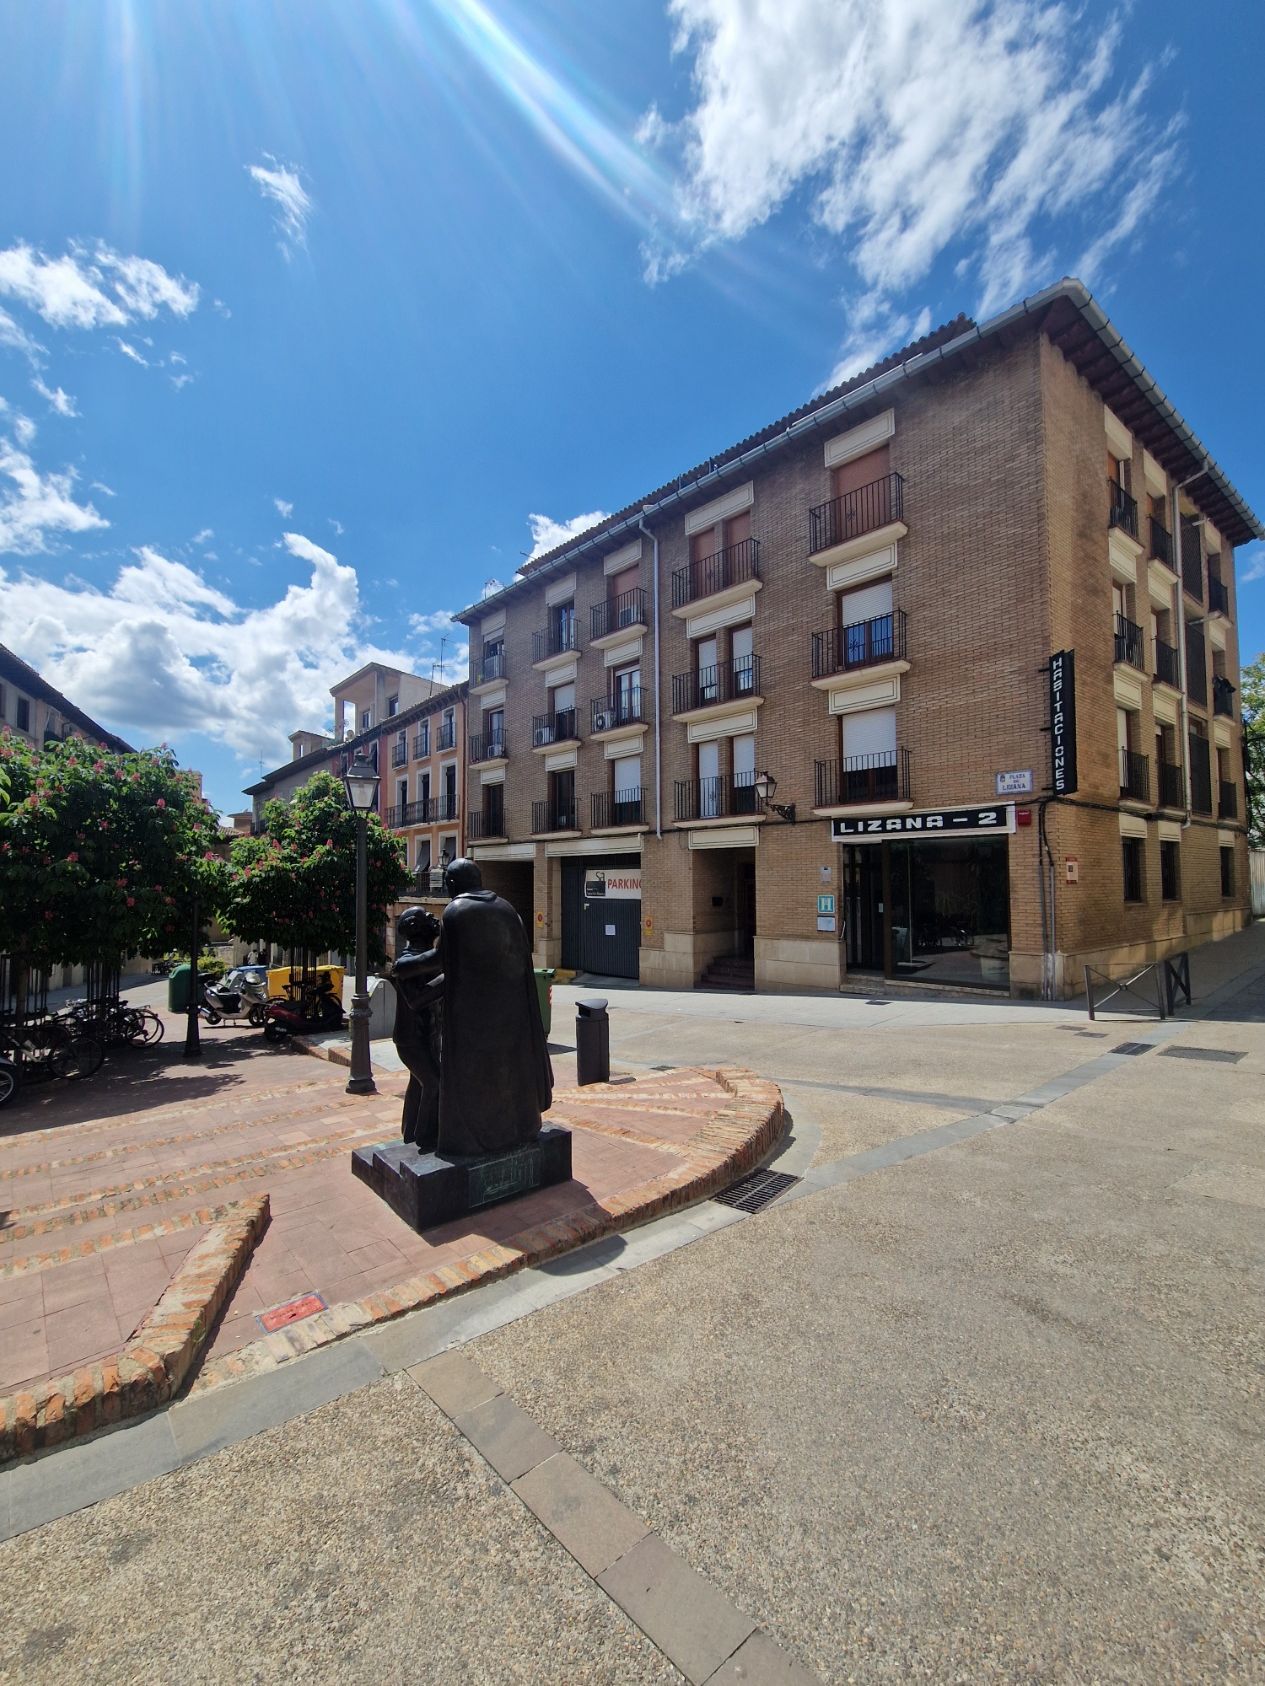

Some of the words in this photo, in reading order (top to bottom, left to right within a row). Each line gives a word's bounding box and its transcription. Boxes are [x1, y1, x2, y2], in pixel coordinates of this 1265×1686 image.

[1052, 657, 1065, 790] HABITACIONES
[840, 815, 944, 833] LIZANA
[978, 812, 997, 825] 2
[607, 879, 641, 889] PARKIN
